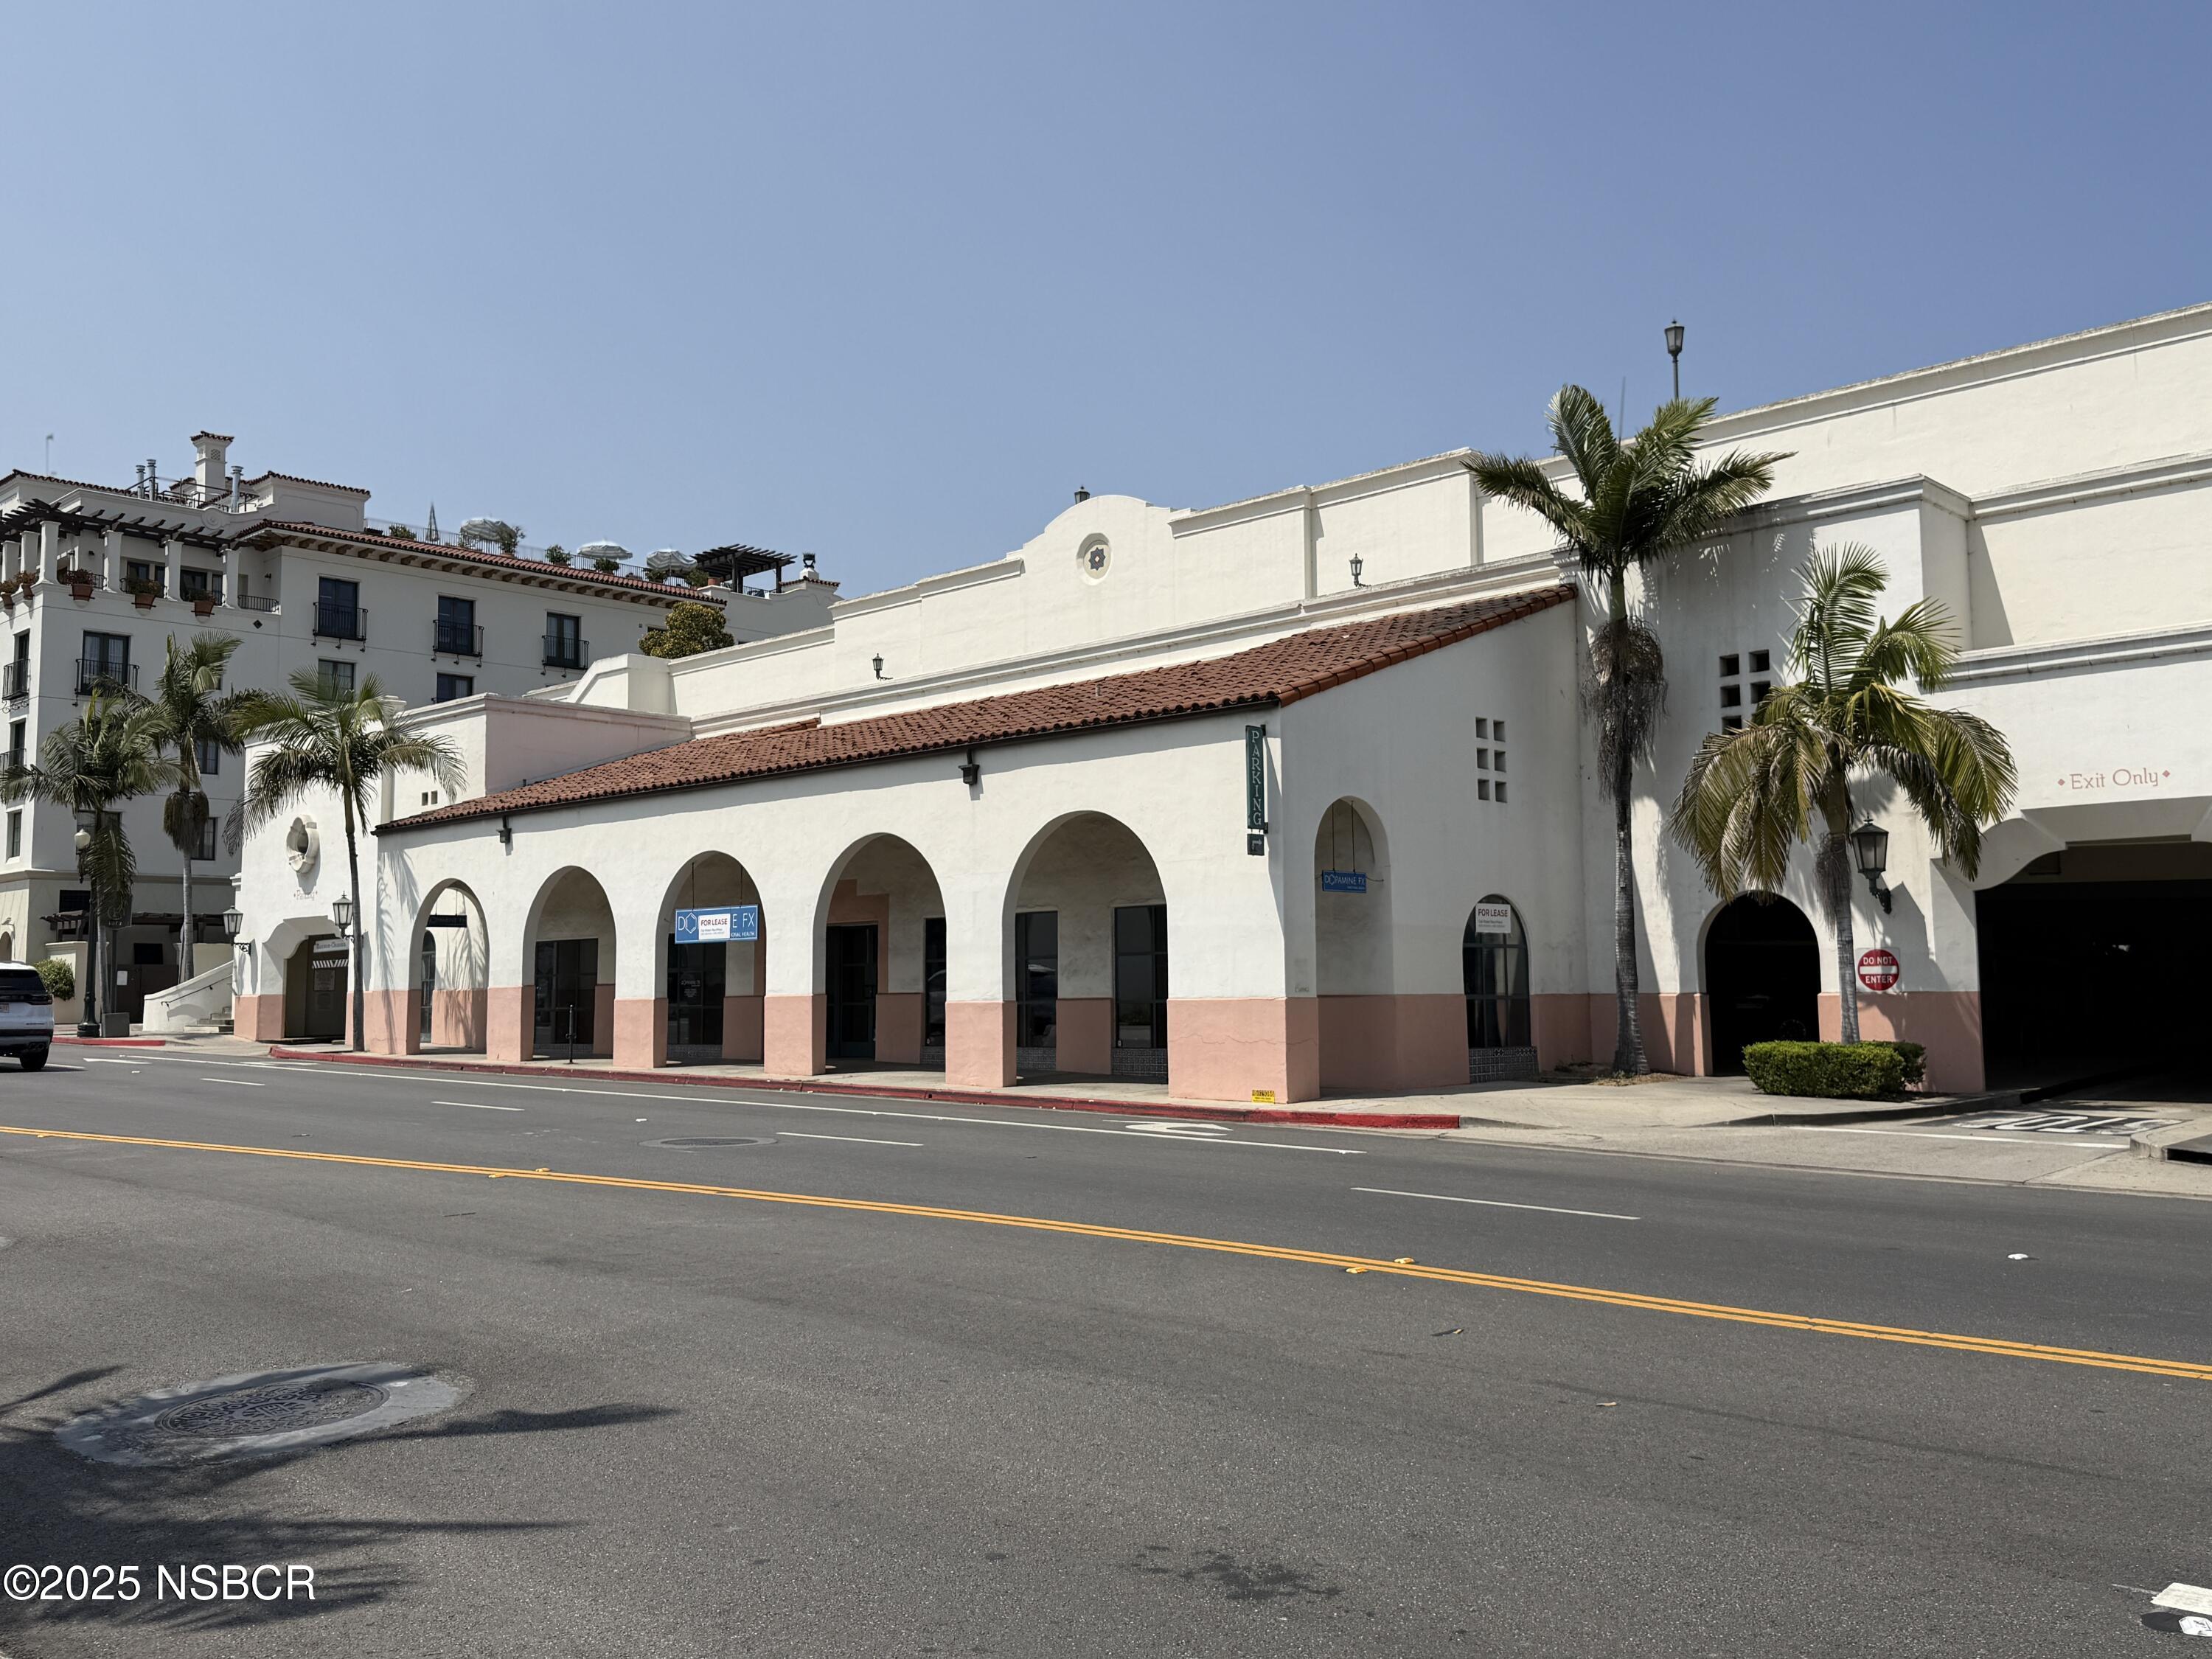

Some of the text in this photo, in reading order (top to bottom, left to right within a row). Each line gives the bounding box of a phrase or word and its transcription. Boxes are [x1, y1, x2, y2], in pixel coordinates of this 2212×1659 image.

[1251, 730, 1262, 825] PARKING
[2069, 768, 2159, 790] Exit Only
[1324, 873, 1365, 886] DOPAMINE FX
[1478, 908, 1509, 917] FOR LEASE
[712, 918, 728, 926] LEASE
[742, 912, 755, 928] FX
[1863, 956, 1893, 965] DO NOT
[1865, 975, 1893, 984] ENTER
